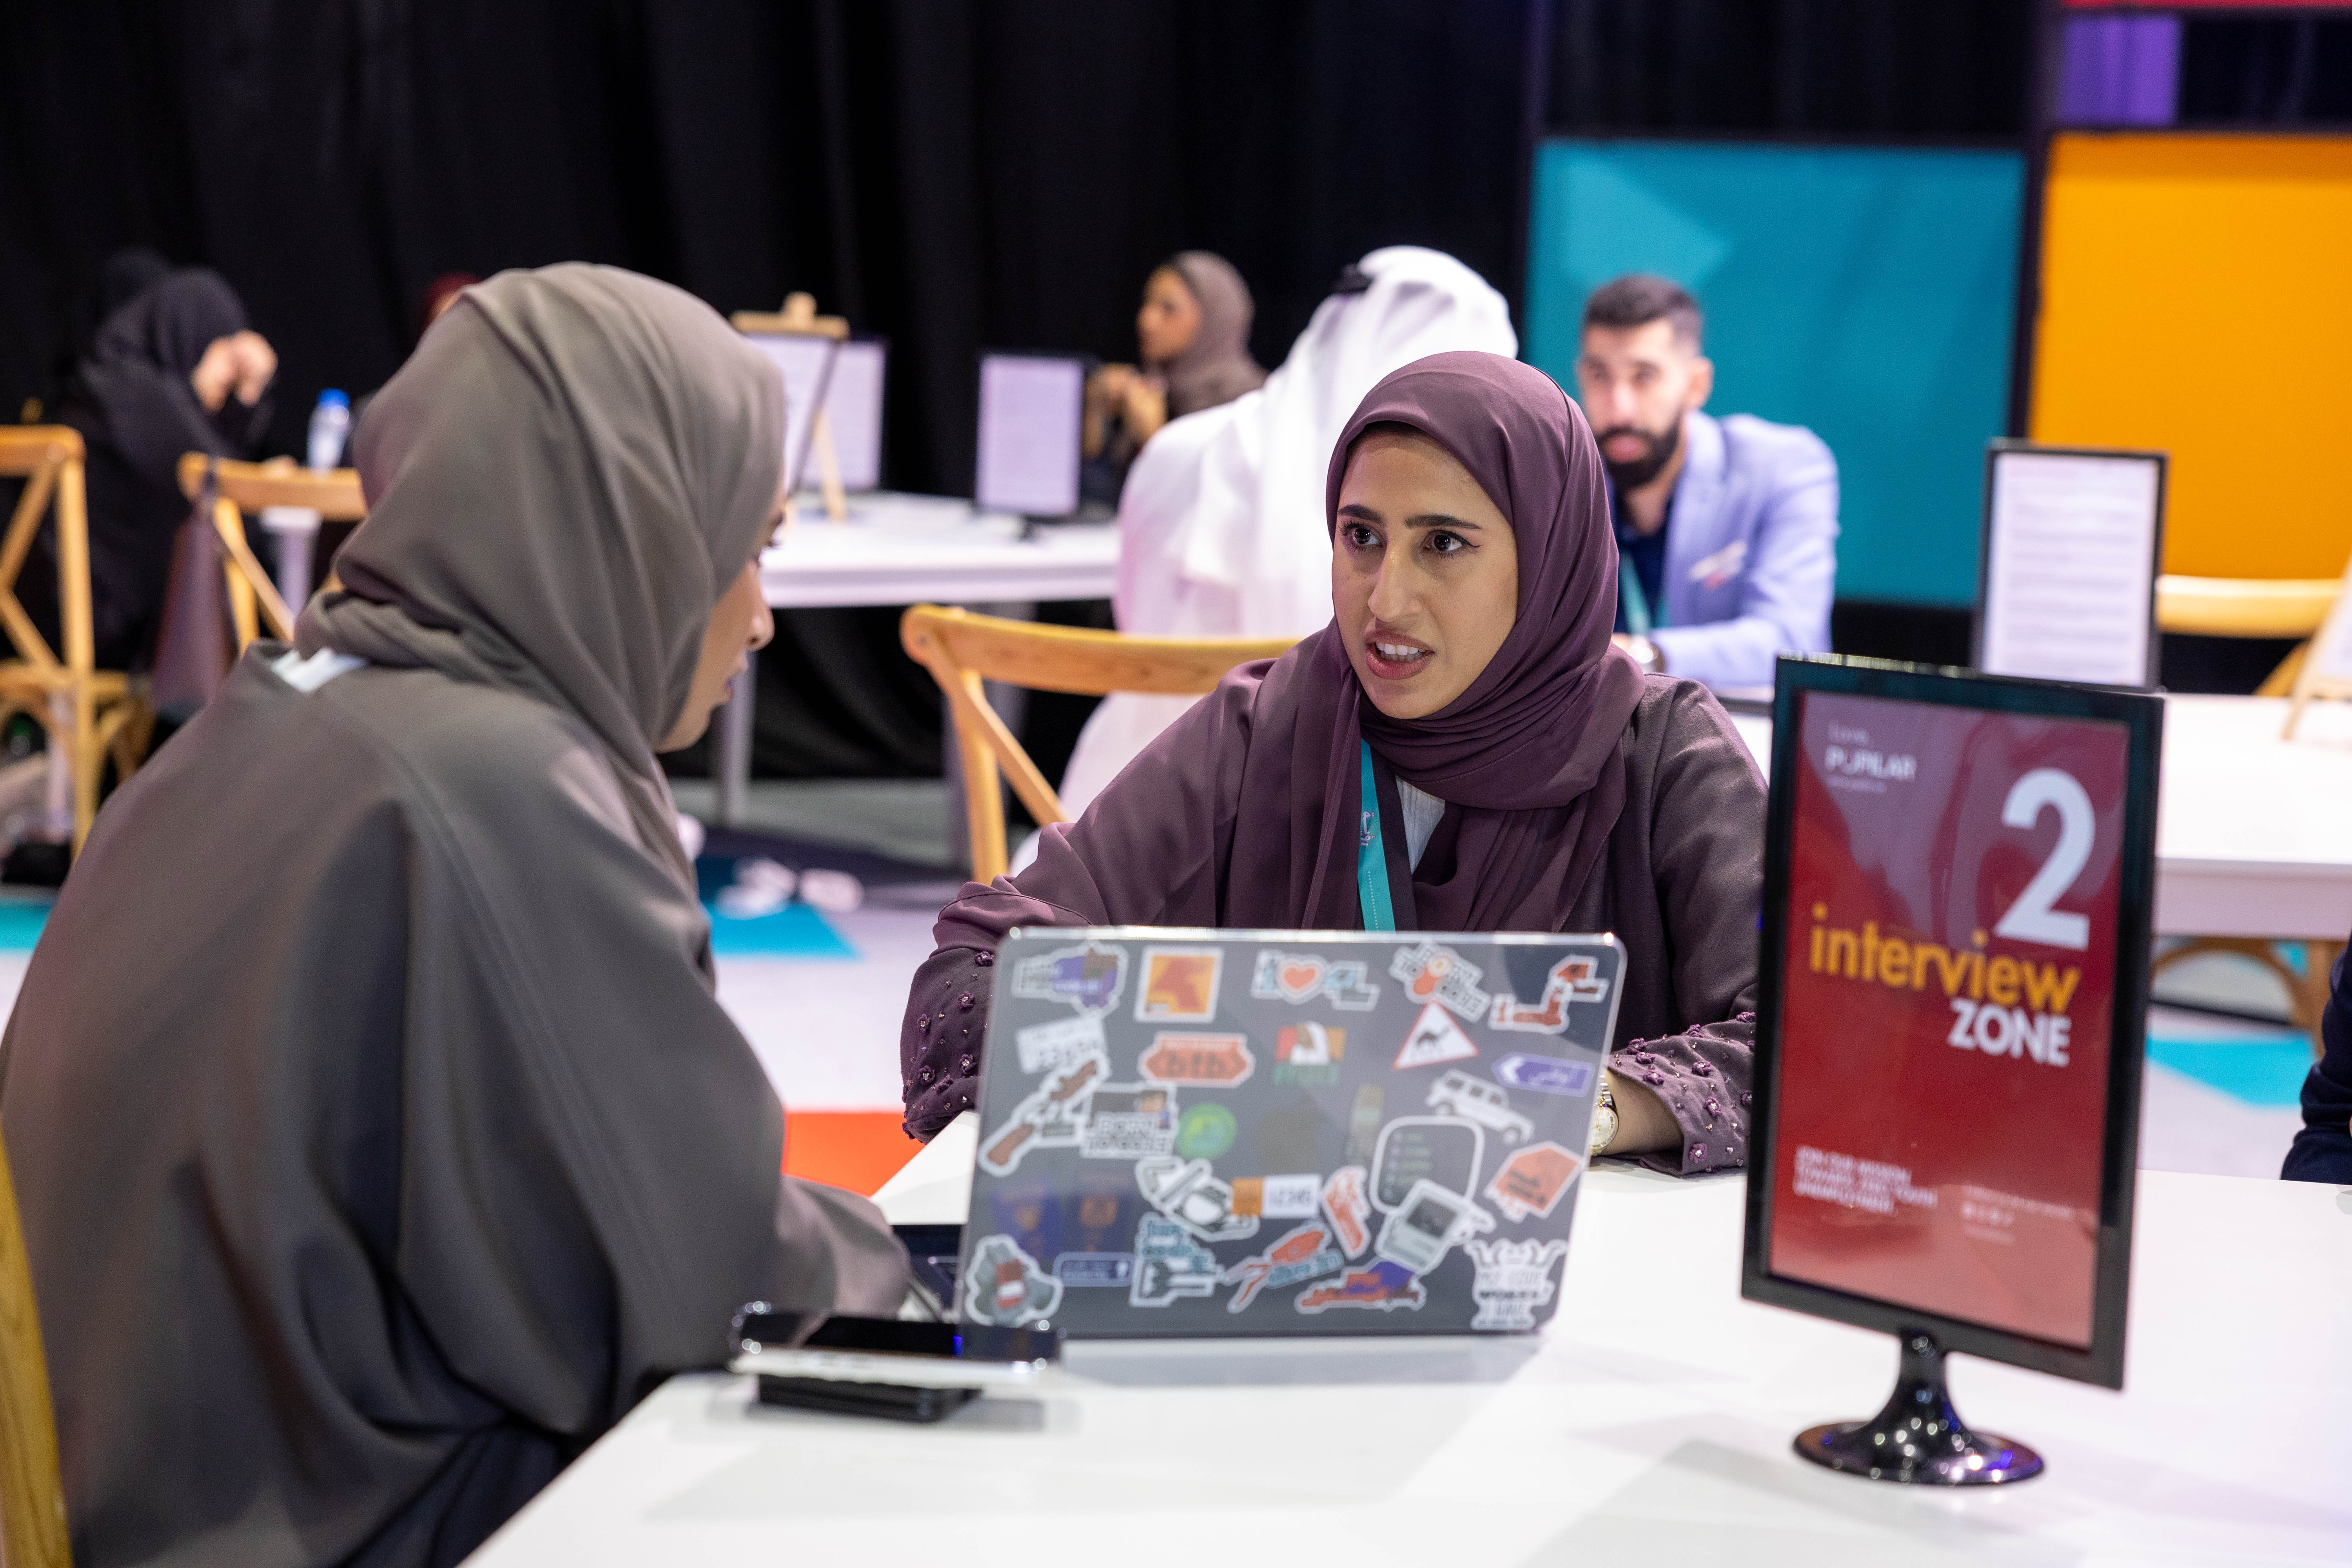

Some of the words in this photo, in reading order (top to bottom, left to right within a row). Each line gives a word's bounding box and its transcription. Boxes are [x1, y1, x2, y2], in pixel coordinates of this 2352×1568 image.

[1995, 768, 2095, 951] 2
[1809, 902, 2082, 1014] interview
[1947, 998, 2071, 1067] ZONE
